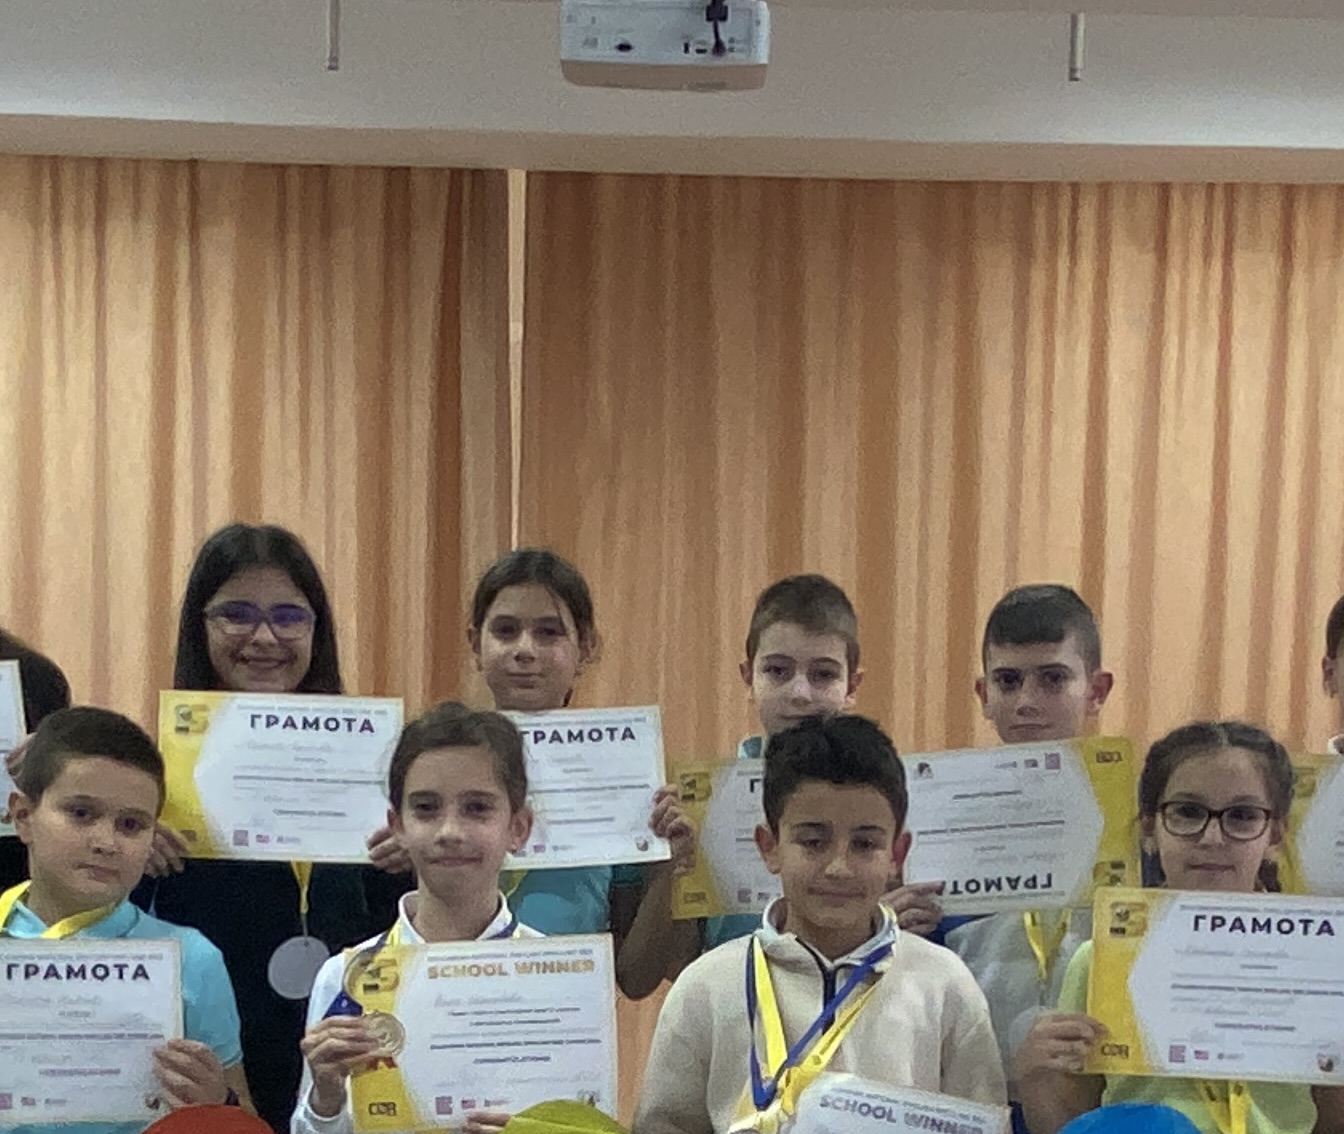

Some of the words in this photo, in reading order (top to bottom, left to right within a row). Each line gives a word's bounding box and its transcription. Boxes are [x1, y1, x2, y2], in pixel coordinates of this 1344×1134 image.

[250, 714, 376, 734] ГРАМОТА
[1193, 915, 1336, 937] ГРАМОТА
[7, 963, 150, 981] ГРАМОТА
[427, 961, 509, 980] SCHOOL
[514, 958, 595, 976] WINNER
[819, 1095, 897, 1124] SCHOOL
